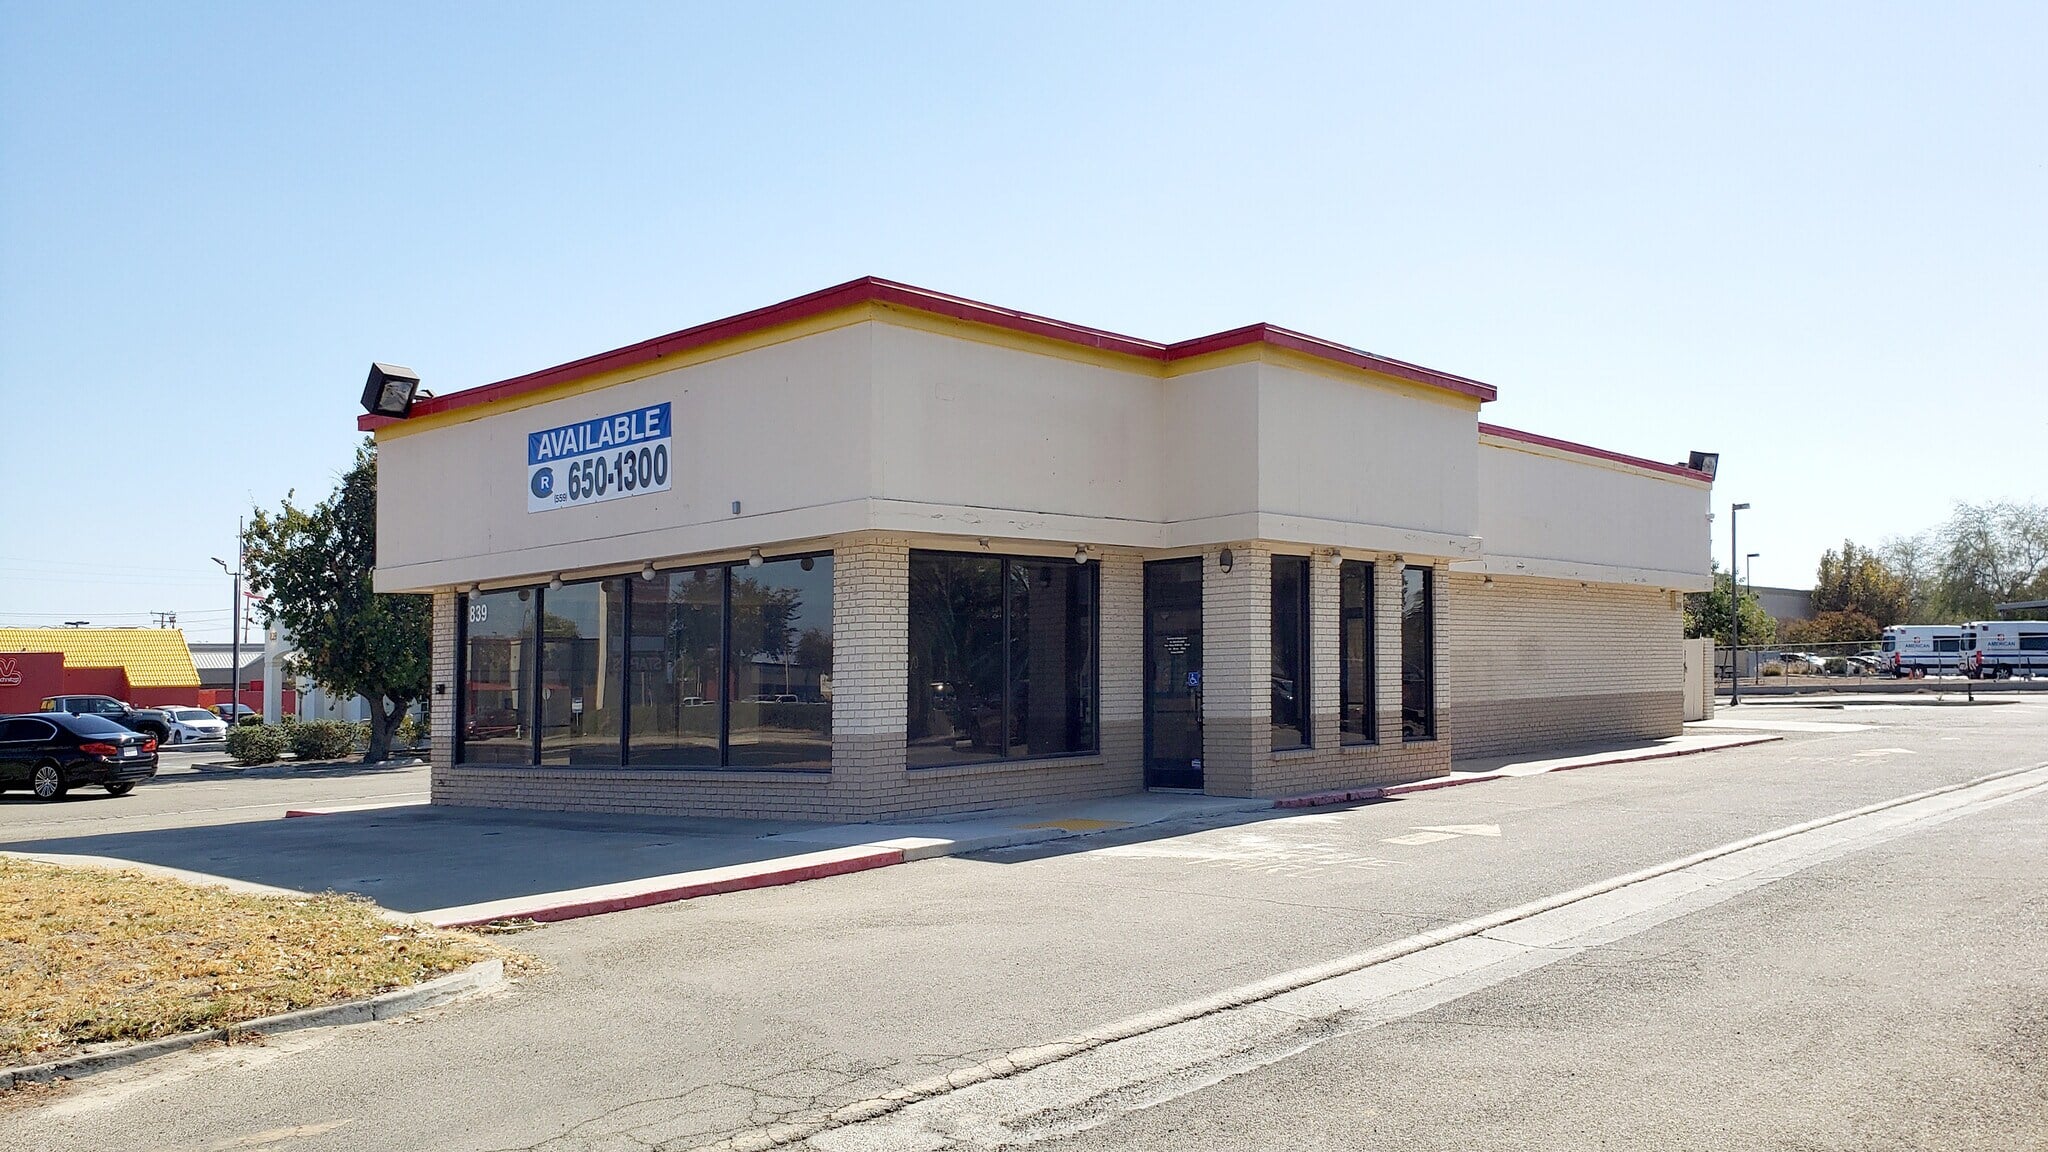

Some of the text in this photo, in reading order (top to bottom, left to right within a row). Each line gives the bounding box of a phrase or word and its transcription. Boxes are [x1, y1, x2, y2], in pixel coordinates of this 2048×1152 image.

[537, 408, 661, 460] AVAILABLE
[541, 476, 549, 490] R
[568, 444, 668, 501] 650-1300
[469, 604, 488, 623] 839
